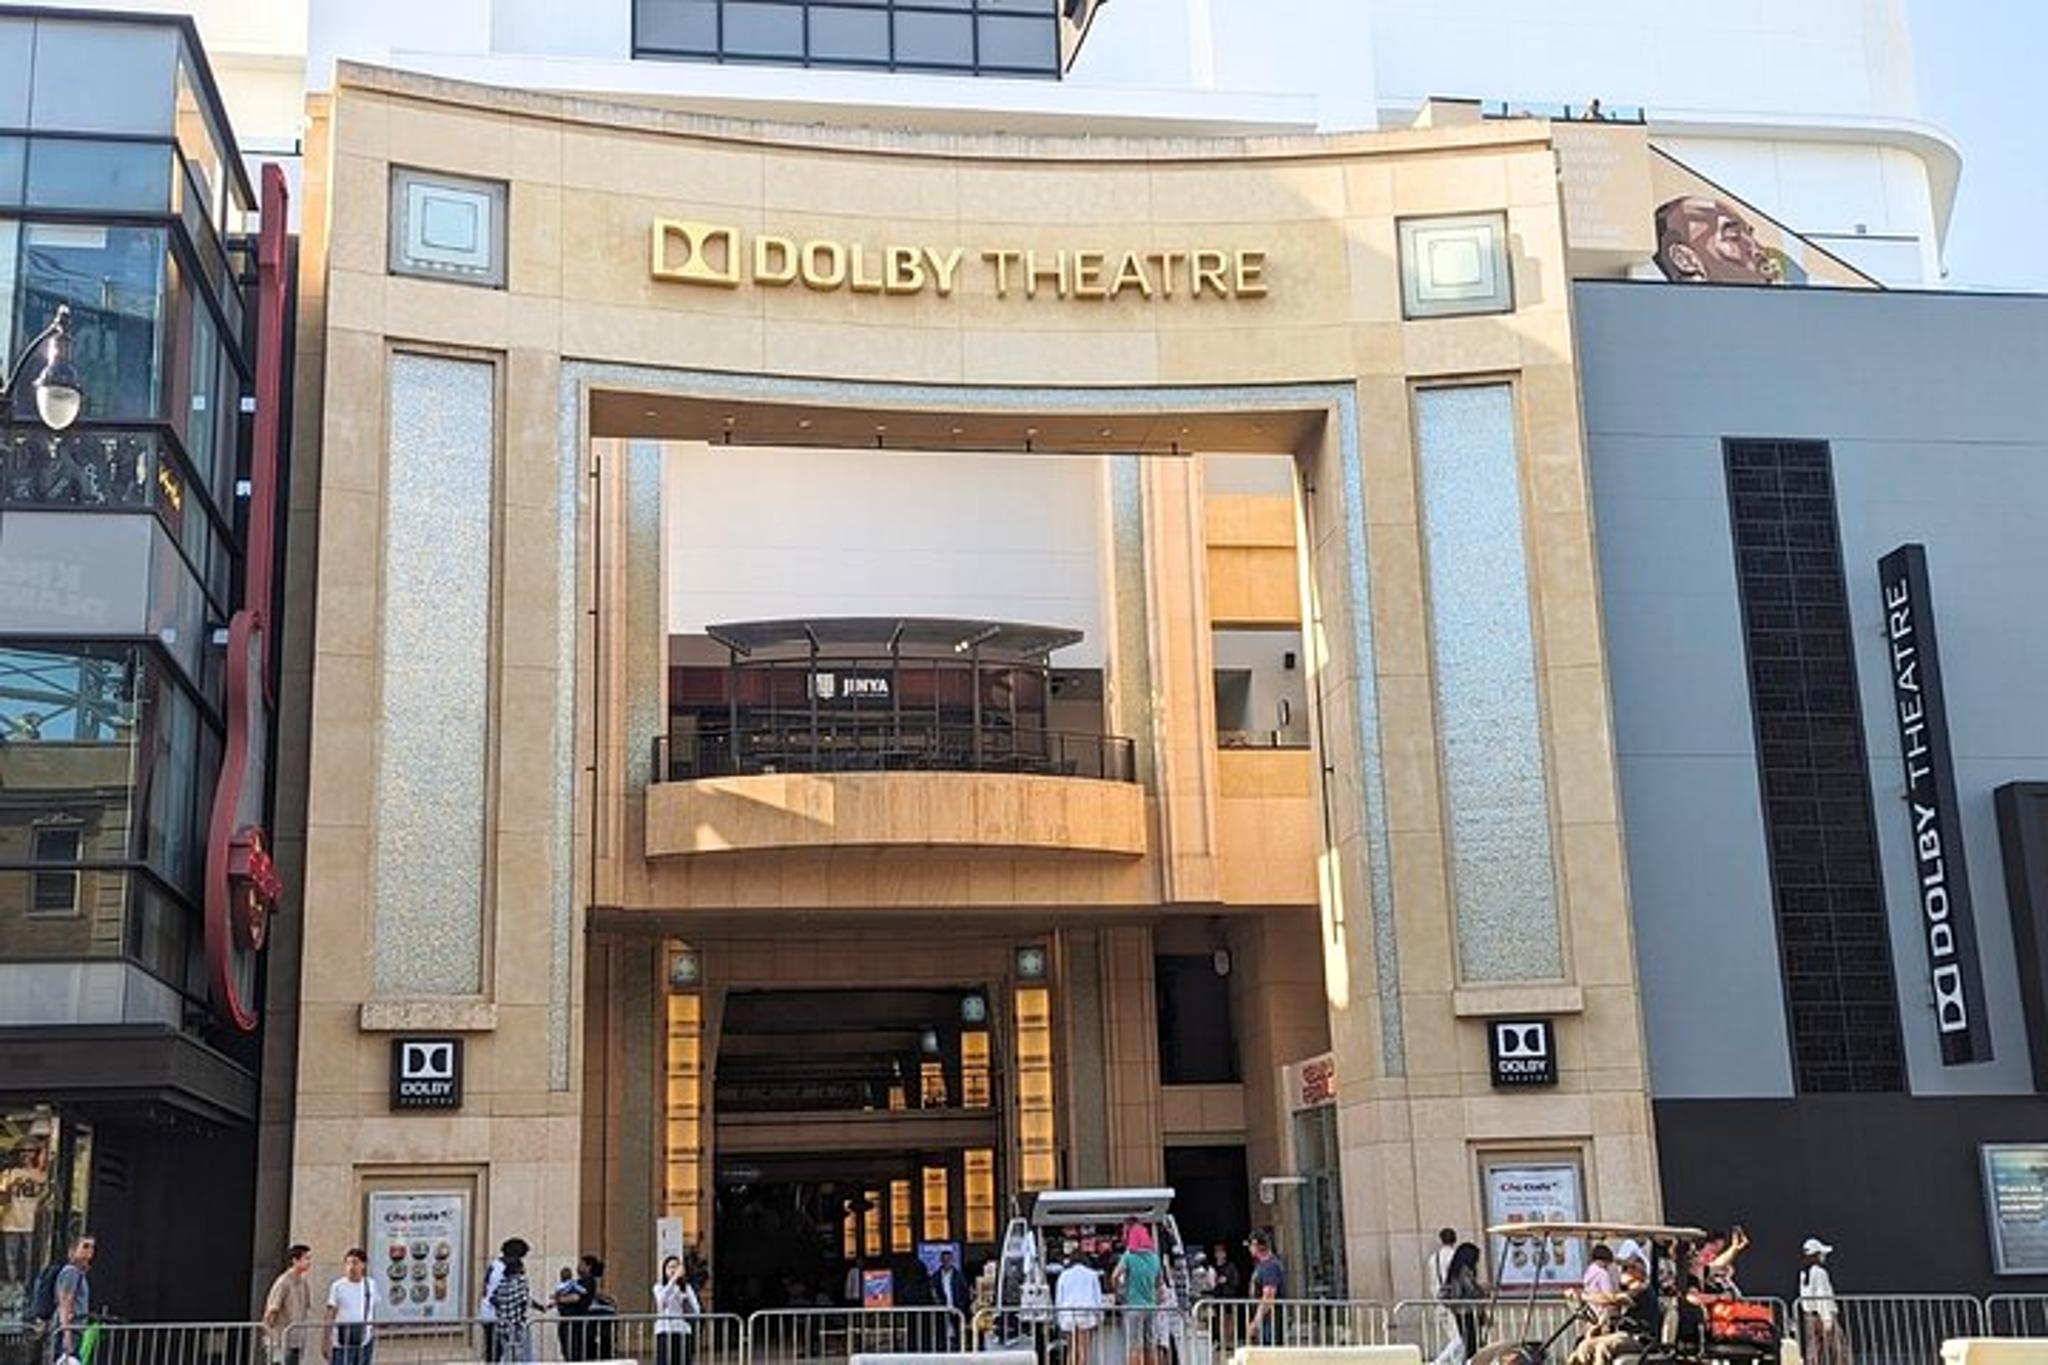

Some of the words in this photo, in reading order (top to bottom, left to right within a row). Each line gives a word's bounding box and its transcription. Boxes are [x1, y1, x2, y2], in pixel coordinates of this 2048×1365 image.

[754, 234, 964, 298] DOLBY
[981, 249, 1268, 299] THEATRE
[842, 678, 889, 697] JINYA
[1885, 578, 1930, 790] THEATRE
[1914, 803, 1954, 957] DOLBY
[1499, 1059, 1548, 1073] DOLBY
[400, 1080, 453, 1096] DOLBY
